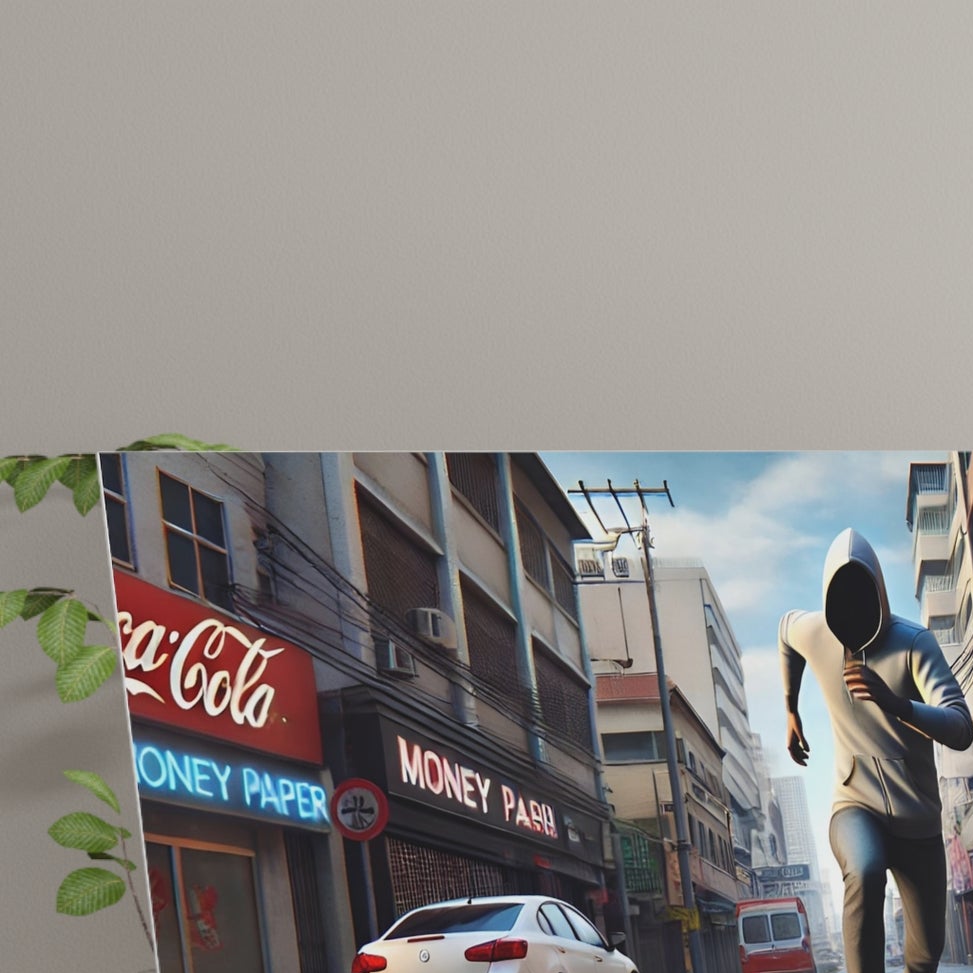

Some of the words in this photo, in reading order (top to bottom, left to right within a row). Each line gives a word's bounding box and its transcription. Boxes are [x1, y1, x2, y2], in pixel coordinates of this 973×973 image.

[134, 744, 231, 801] ONEY
[242, 766, 330, 822] PAPER
[396, 735, 491, 814] MONEY
